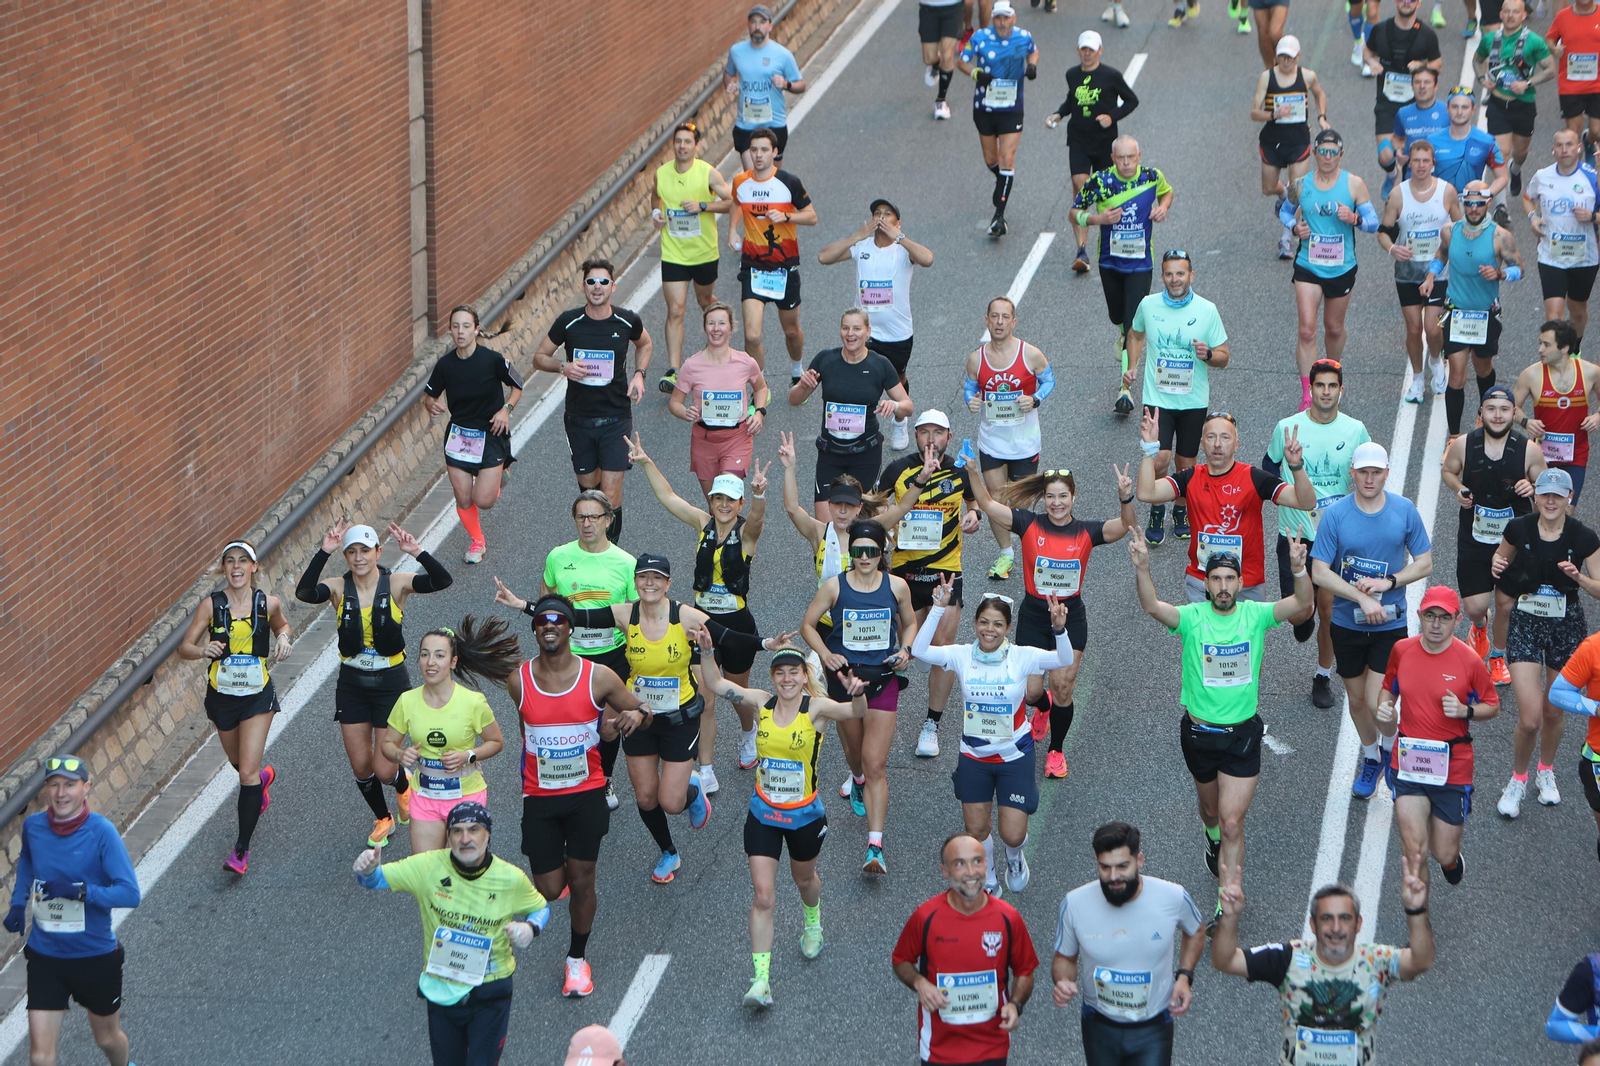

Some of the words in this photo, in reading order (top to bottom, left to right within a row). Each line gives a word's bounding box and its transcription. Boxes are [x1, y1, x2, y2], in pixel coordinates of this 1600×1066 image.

[752, 204, 768, 212] FUN
[985, 372, 1021, 389] ITALIA
[462, 430, 482, 438] ZURICH
[1051, 560, 1076, 568] ZURICH
[1356, 561, 1381, 570] ZURICH
[1219, 645, 1246, 655] ZURICH
[1219, 661, 1238, 670] 10126
[646, 693, 664, 701] 11187
[529, 731, 590, 746] GLASSDOOR
[552, 749, 580, 759] ZURICH
[1415, 756, 1431, 764] 7936
[552, 764, 573, 772] 10392
[771, 762, 797, 770] ZURICH
[1411, 766, 1434, 775] SAMUEL
[540, 770, 587, 780] INCREDIBLEHAWK
[454, 934, 486, 948] ZURICH
[449, 961, 466, 971] AGUS
[958, 974, 989, 986] ZURICH
[1114, 973, 1145, 983] ZURICH
[1112, 990, 1133, 998] 10293
[1316, 1034, 1348, 1044] ZURICH
[1314, 1051, 1337, 1060] 11028
